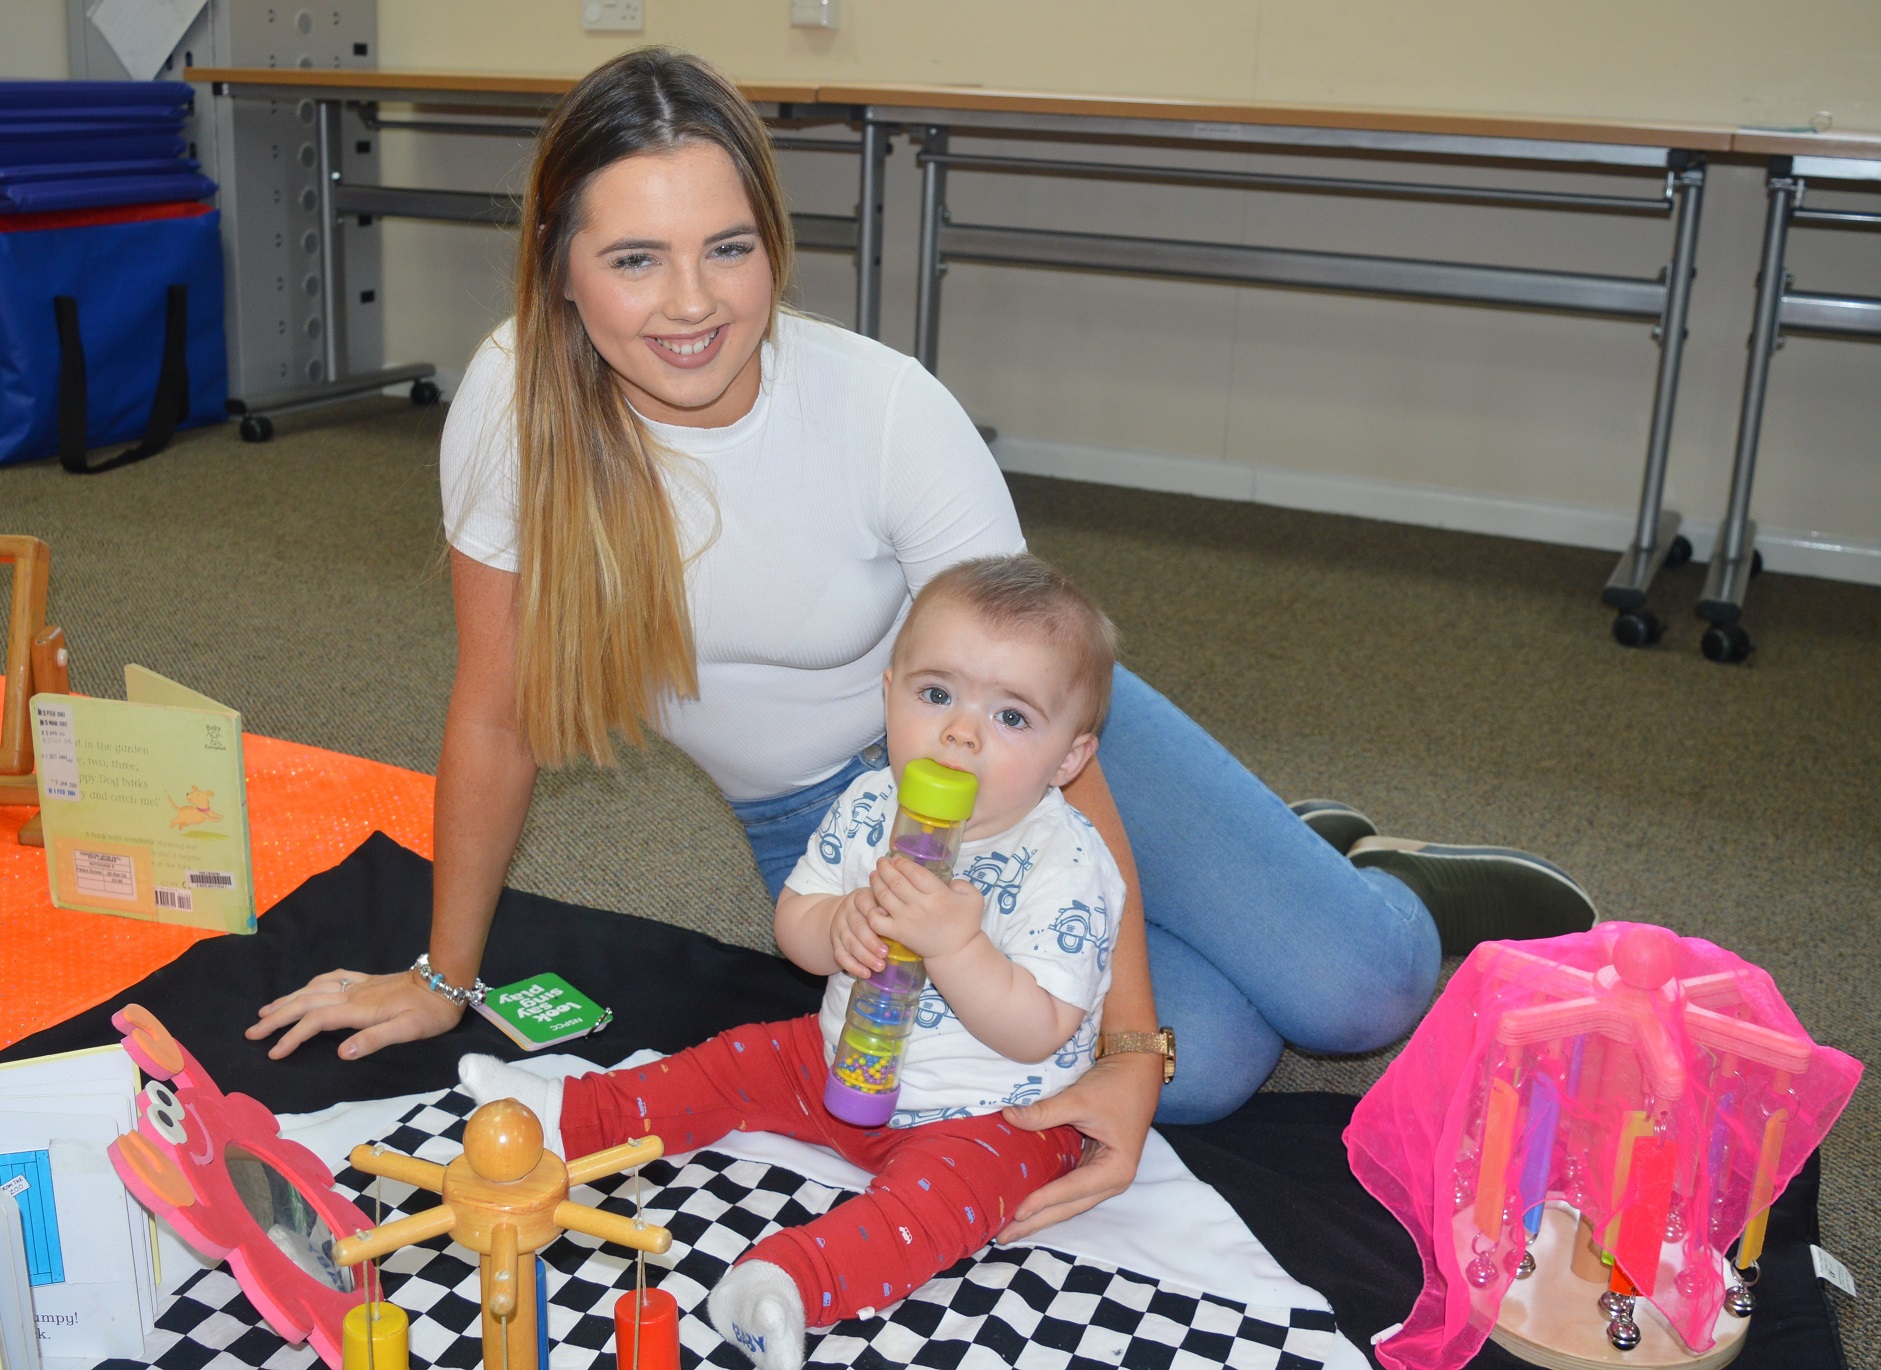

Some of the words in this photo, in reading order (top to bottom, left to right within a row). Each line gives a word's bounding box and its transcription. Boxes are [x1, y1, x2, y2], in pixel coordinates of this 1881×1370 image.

[115, 744, 149, 754] garden
[99, 774, 119, 788] Dog
[122, 777, 148, 789] barks
[89, 791, 108, 801] and
[110, 794, 137, 805] catch
[499, 984, 545, 1004] play
[519, 988, 564, 1008] sing
[517, 1002, 553, 1019] say
[550, 1017, 583, 1031] NSPCC
[34, 1312, 79, 1326] umpy!
[732, 1322, 766, 1353] BABY
